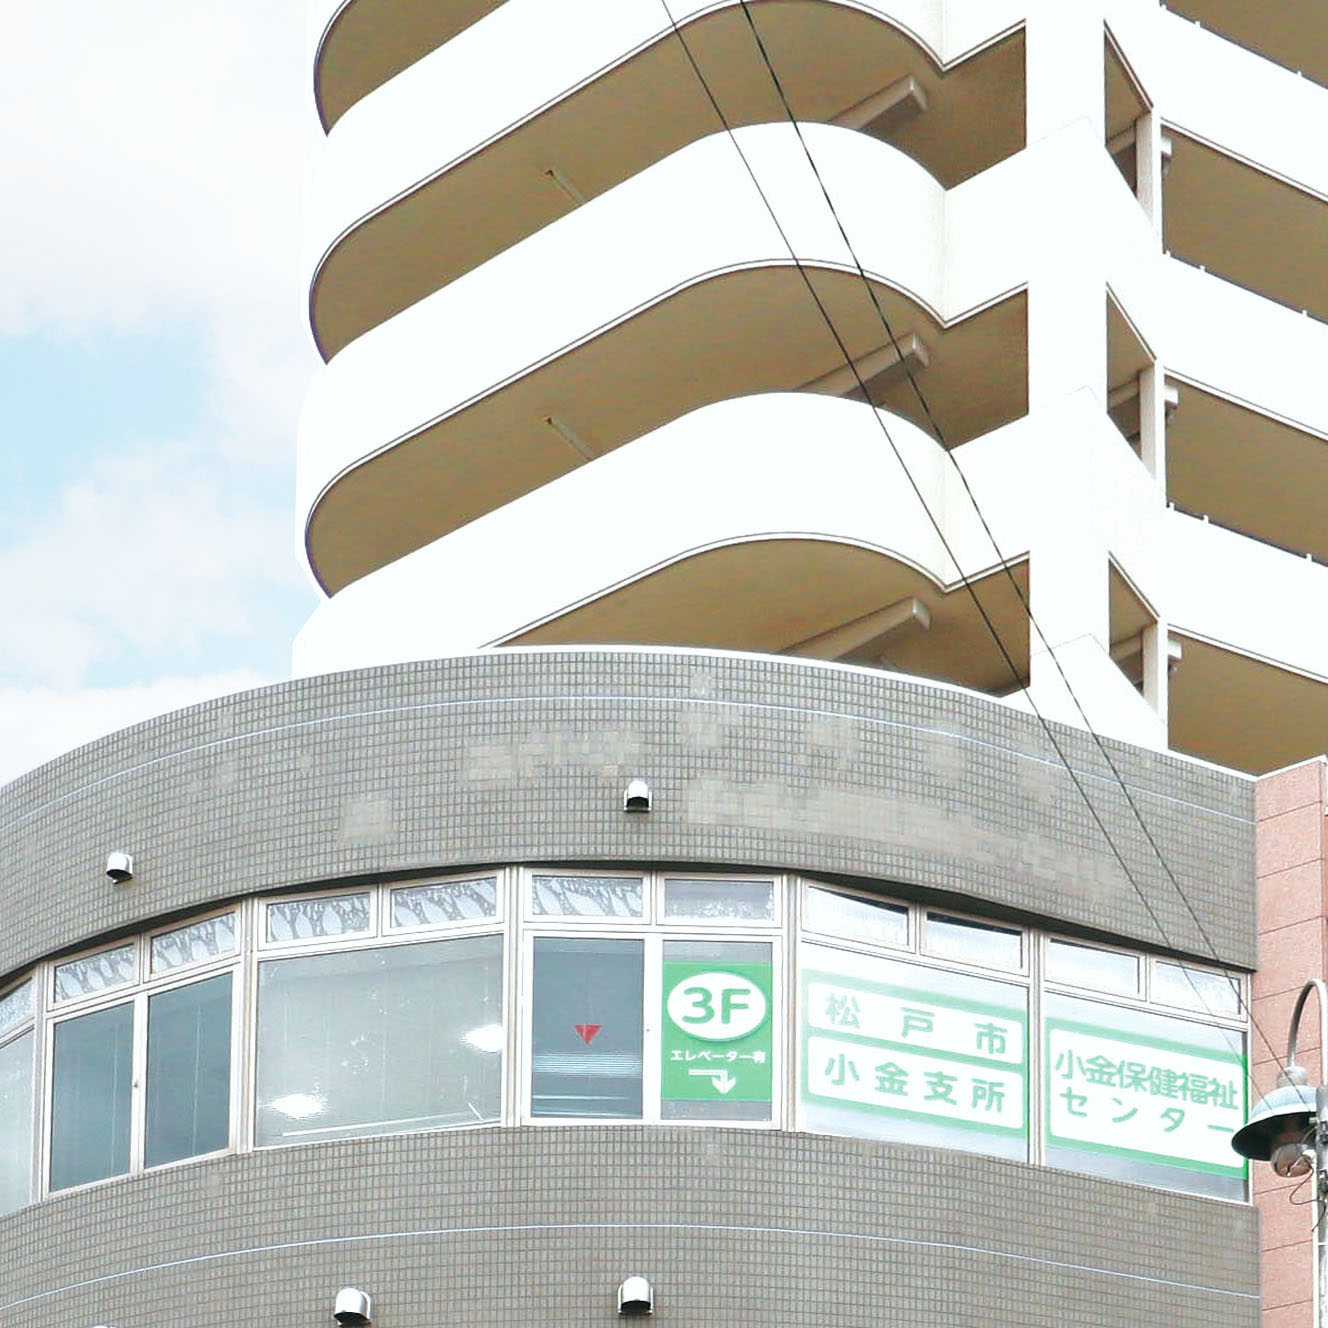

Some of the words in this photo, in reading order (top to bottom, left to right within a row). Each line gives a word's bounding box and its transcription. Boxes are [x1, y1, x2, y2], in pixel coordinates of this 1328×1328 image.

[682, 986, 751, 1025] 3F
[825, 996, 1008, 1055] 松戸市
[670, 1048, 767, 1064] エレベーター有
[823, 1052, 1005, 1113] 小金支所
[1056, 1049, 1238, 1112] 小金保健福祉
[1061, 1085, 1236, 1135] センター
